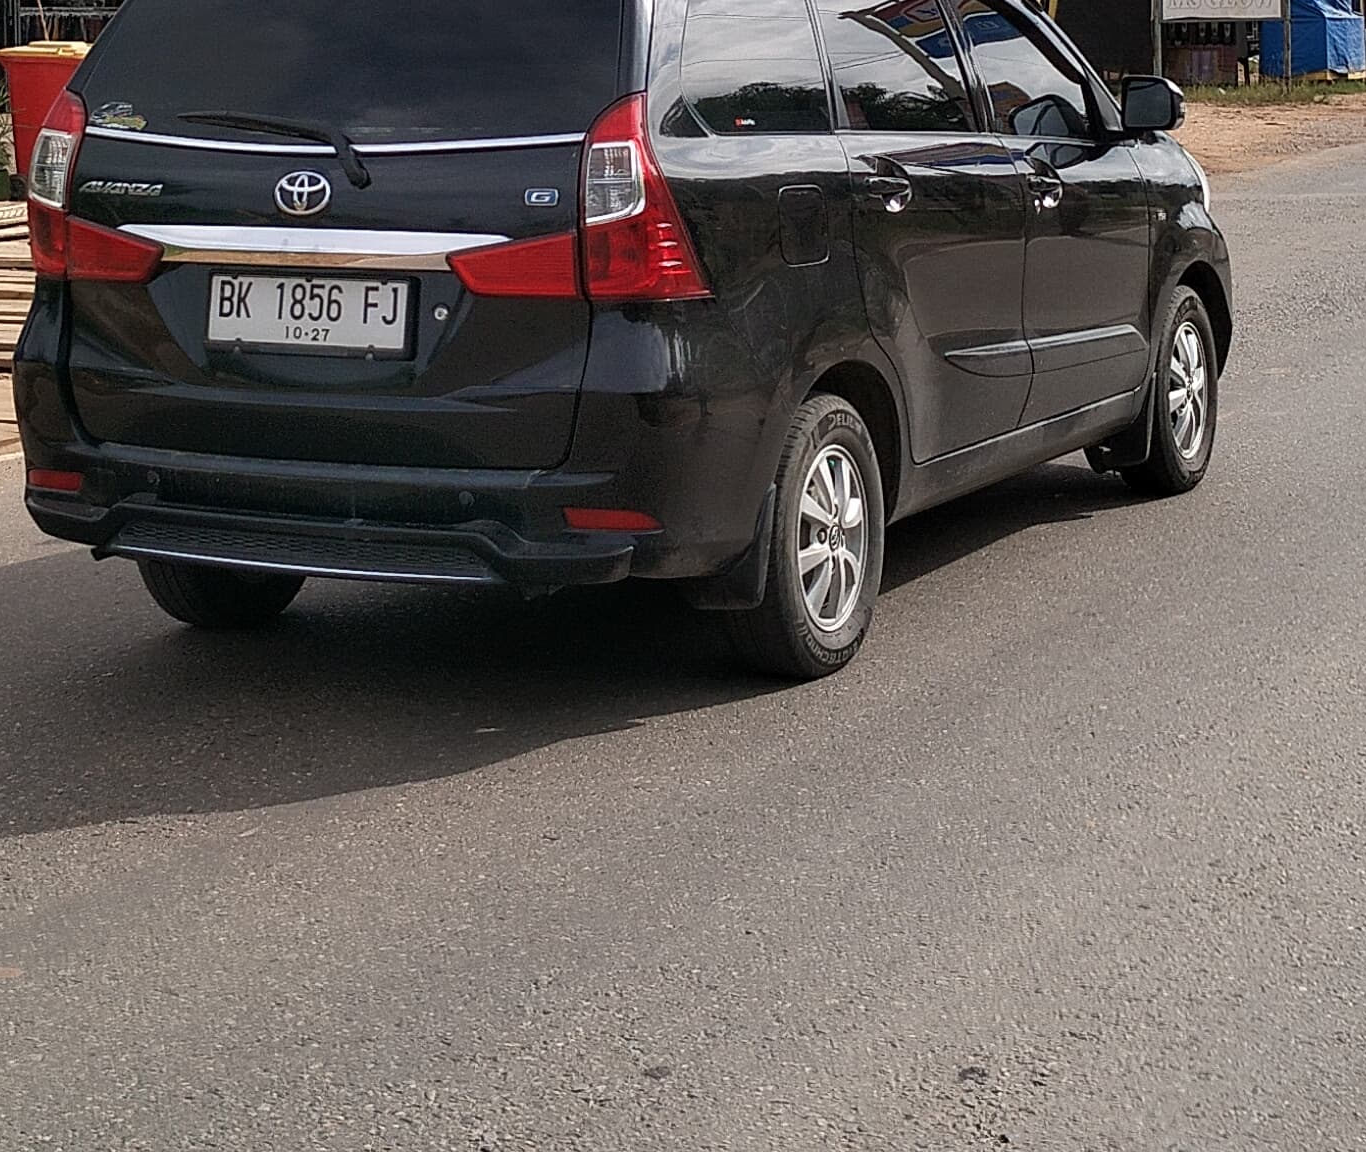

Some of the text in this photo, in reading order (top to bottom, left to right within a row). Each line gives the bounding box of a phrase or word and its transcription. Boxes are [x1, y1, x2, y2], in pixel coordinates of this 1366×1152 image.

[78, 180, 164, 197] AVANZA
[218, 279, 399, 326] BK 1856 FJ
